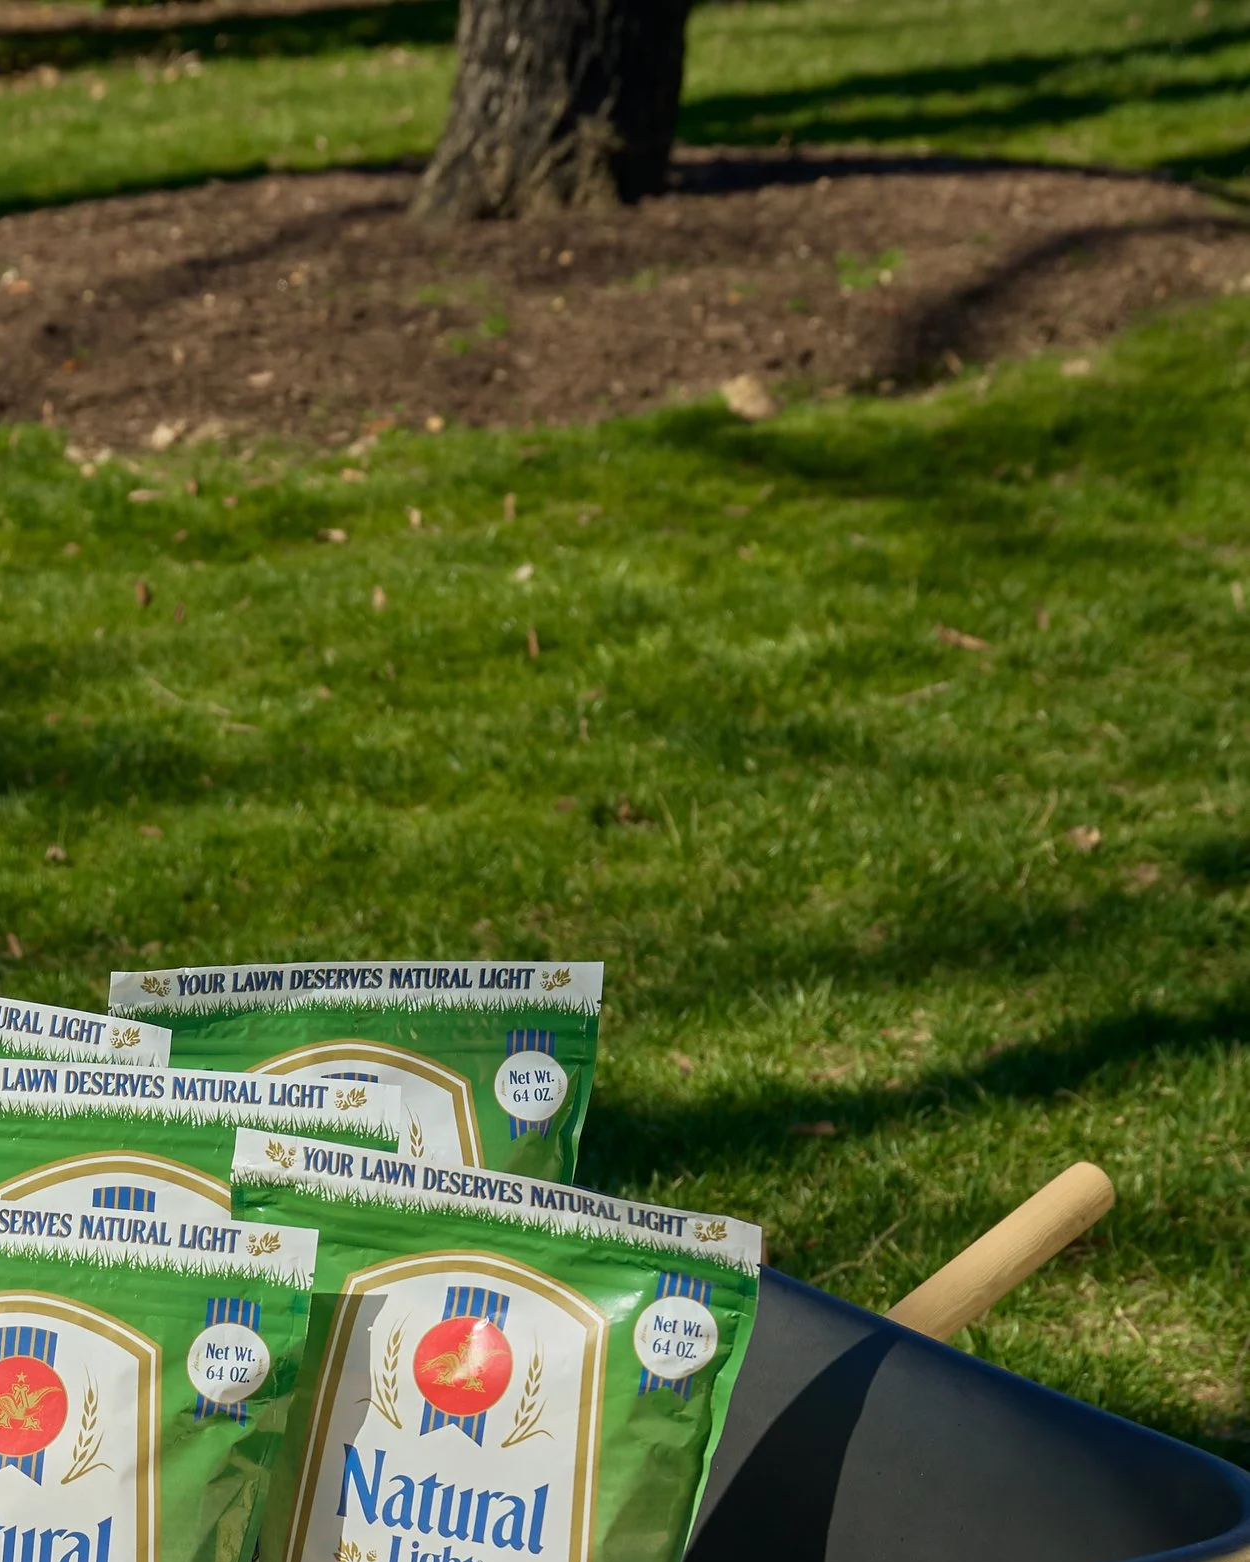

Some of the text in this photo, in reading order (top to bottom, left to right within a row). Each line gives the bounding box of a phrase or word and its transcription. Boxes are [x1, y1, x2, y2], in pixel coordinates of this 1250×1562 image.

[176, 968, 535, 996] YOUR LAWN DESERVES NATURAL LIGHT
[50, 1017, 107, 1046] LIGHT
[2, 1068, 57, 1093] LAWN
[64, 1071, 165, 1099] DESERVES
[171, 1075, 262, 1104] NATURAL
[268, 1081, 328, 1109] LIGHT
[510, 1070, 555, 1084] Net Wt.
[513, 1089, 529, 1102] 64
[302, 1146, 688, 1238] YOUR LAWN DESERVES NATURAL LIGHT
[79, 1215, 172, 1245] NATURAL
[178, 1223, 241, 1253] LIGHT
[654, 1315, 703, 1337] Net Wt.
[206, 1343, 255, 1362] Net Wt.
[653, 1338, 670, 1355] 64
[206, 1365, 224, 1380] 64
[336, 1443, 549, 1554] Natural
